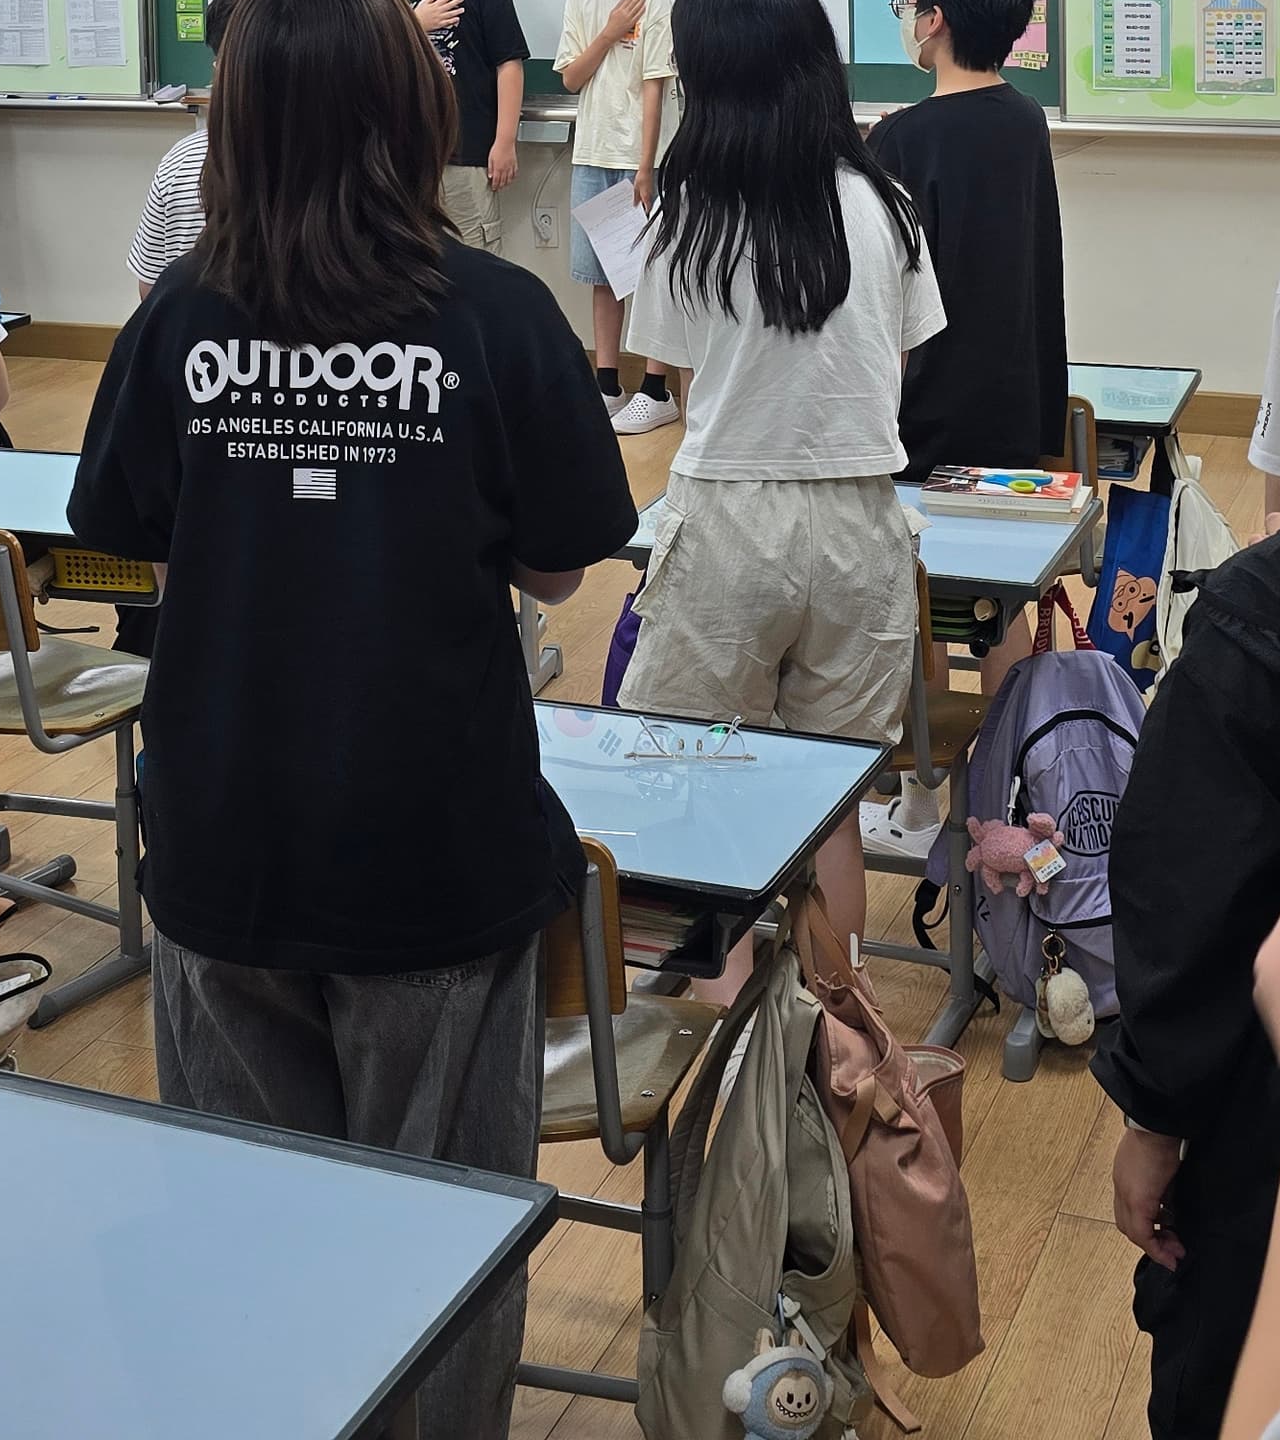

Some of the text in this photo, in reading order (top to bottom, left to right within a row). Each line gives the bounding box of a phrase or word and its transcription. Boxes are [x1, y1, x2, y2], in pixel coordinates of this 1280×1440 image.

[185, 339, 443, 413] OUTDOOR
[230, 391, 387, 408] PRODUCTS
[187, 418, 444, 443] LOS ANGELES CALIFORNIA U.S.A
[227, 442, 396, 464] ESTABLISHED IN 1973
